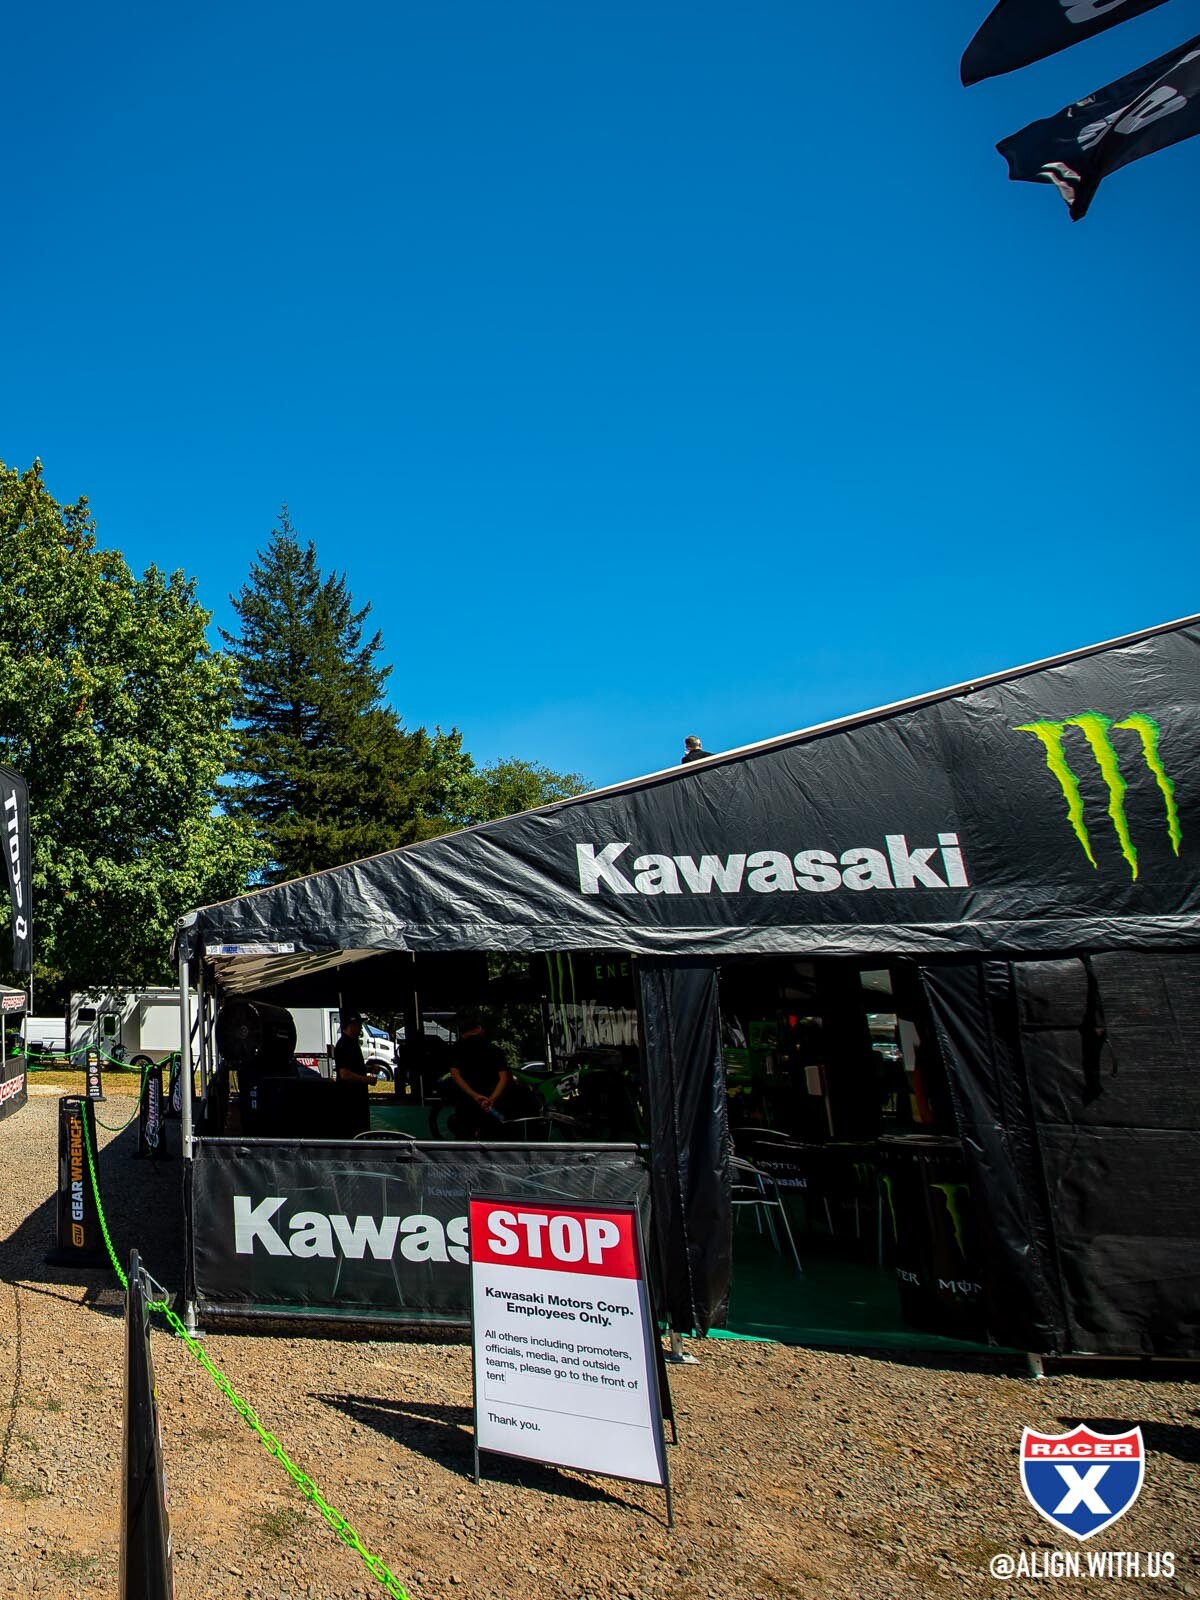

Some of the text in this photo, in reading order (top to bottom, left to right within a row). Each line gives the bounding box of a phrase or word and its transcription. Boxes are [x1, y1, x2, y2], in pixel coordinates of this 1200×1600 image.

[576, 833, 970, 895] Kawasaki
[70, 1116, 84, 1222] GEARWRENCH
[487, 1210, 620, 1264] STOP
[485, 1287, 634, 1316] Kawasaki Motors Corp.
[506, 1302, 612, 1327] Employees Only.
[485, 1330, 632, 1361] All others including promoters,
[485, 1344, 620, 1372] officials, media, and outside
[486, 1358, 638, 1390] teams, please go to the front of
[486, 1371, 504, 1382] tent
[488, 1413, 541, 1431] Thank you.
